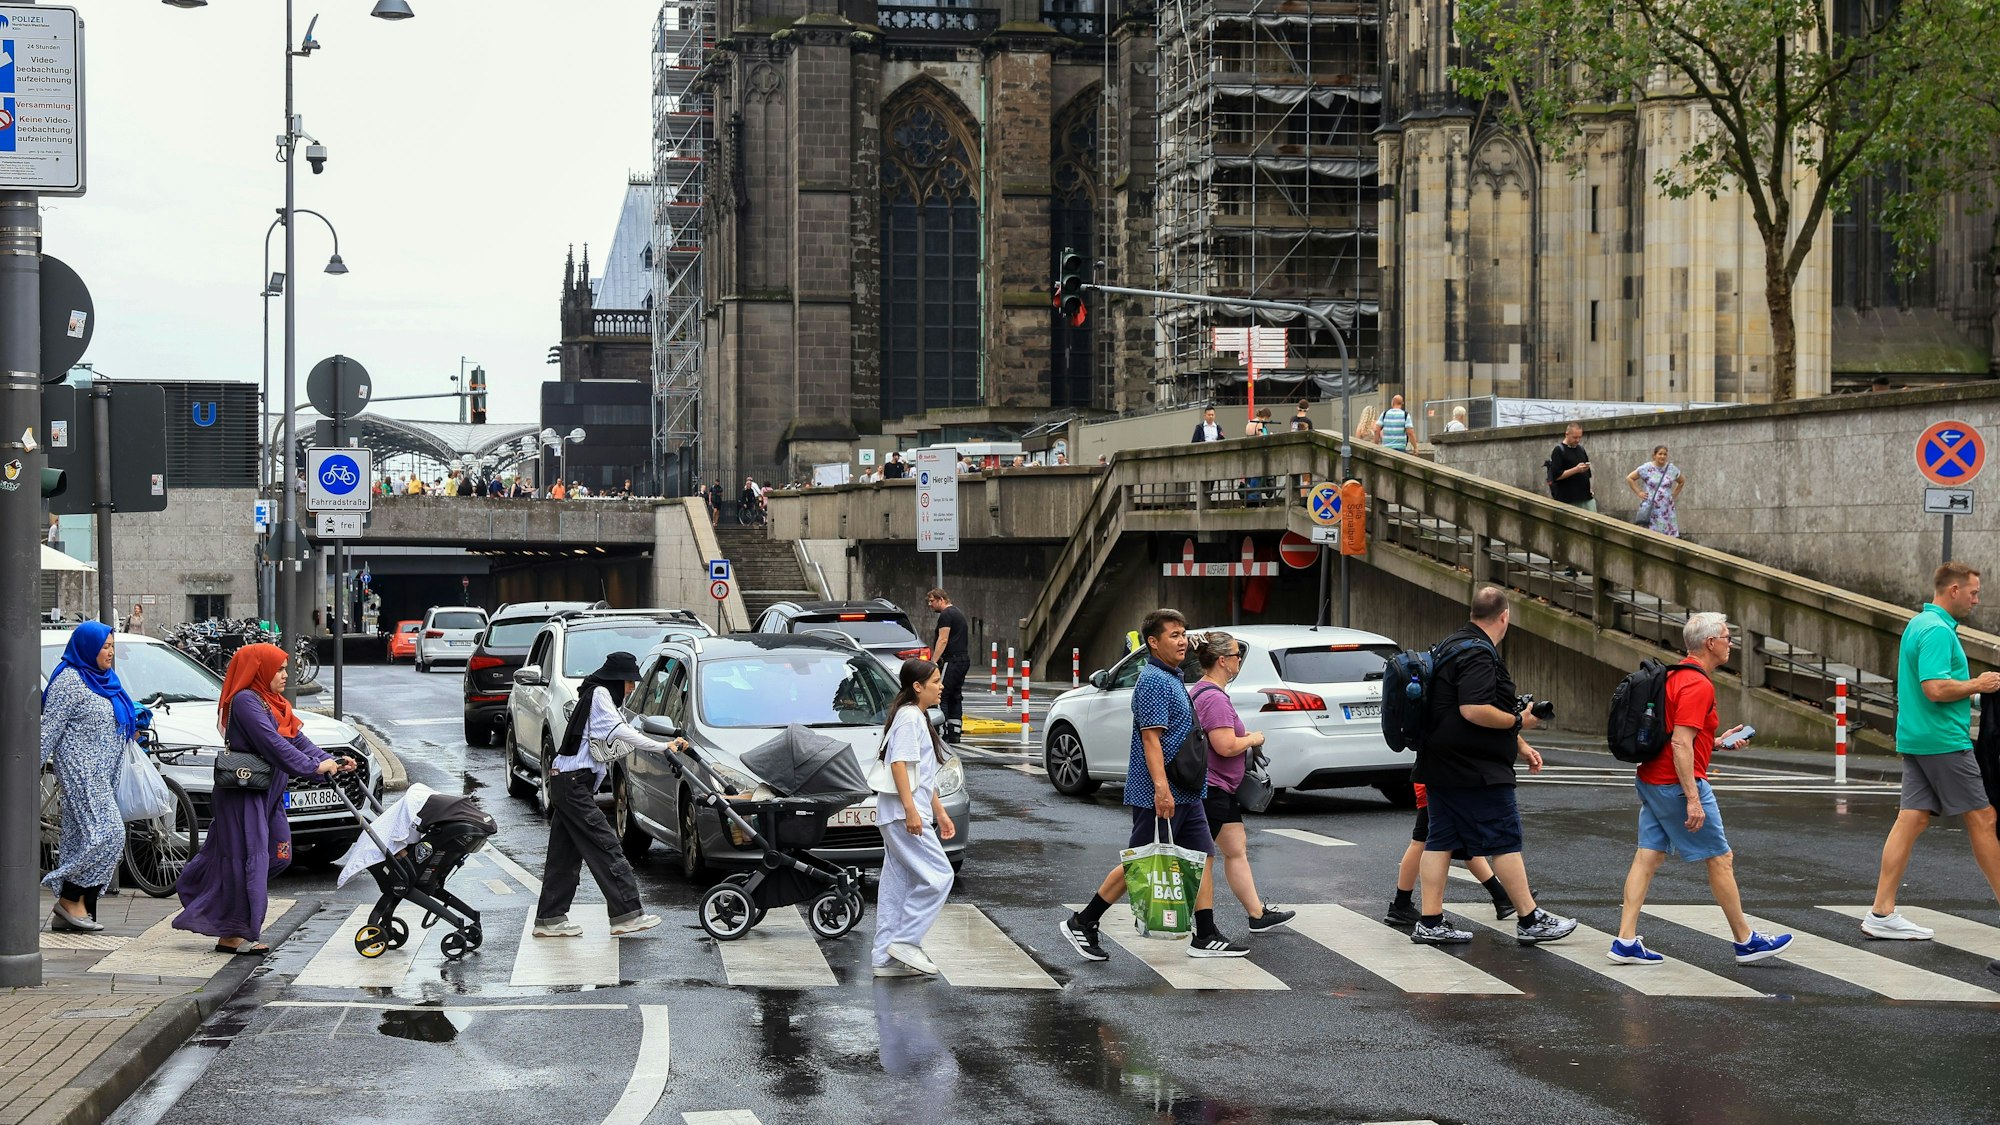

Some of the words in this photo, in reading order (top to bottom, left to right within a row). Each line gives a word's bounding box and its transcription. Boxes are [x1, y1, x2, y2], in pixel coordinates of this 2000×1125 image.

[16, 66, 72, 75] beobachtung/
[16, 75, 71, 85] aufzeichnung
[16, 101, 73, 110] Versammlung:
[45, 116, 71, 124] Video-
[17, 126, 73, 135] beobachtung/
[17, 135, 73, 144] aufzeichnung
[193, 402, 216, 427] U
[933, 476, 943, 484] Hier
[311, 498, 367, 506] Fahrradstraße
[1355, 503, 1363, 520] Sila
[340, 521, 355, 529] frei
[1346, 503, 1355, 546] Signalbau
[1207, 564, 1228, 575] AUSFAHRT
[291, 793, 297, 806] K
[305, 792, 318, 805] XR
[1154, 885, 1182, 900] BAG
